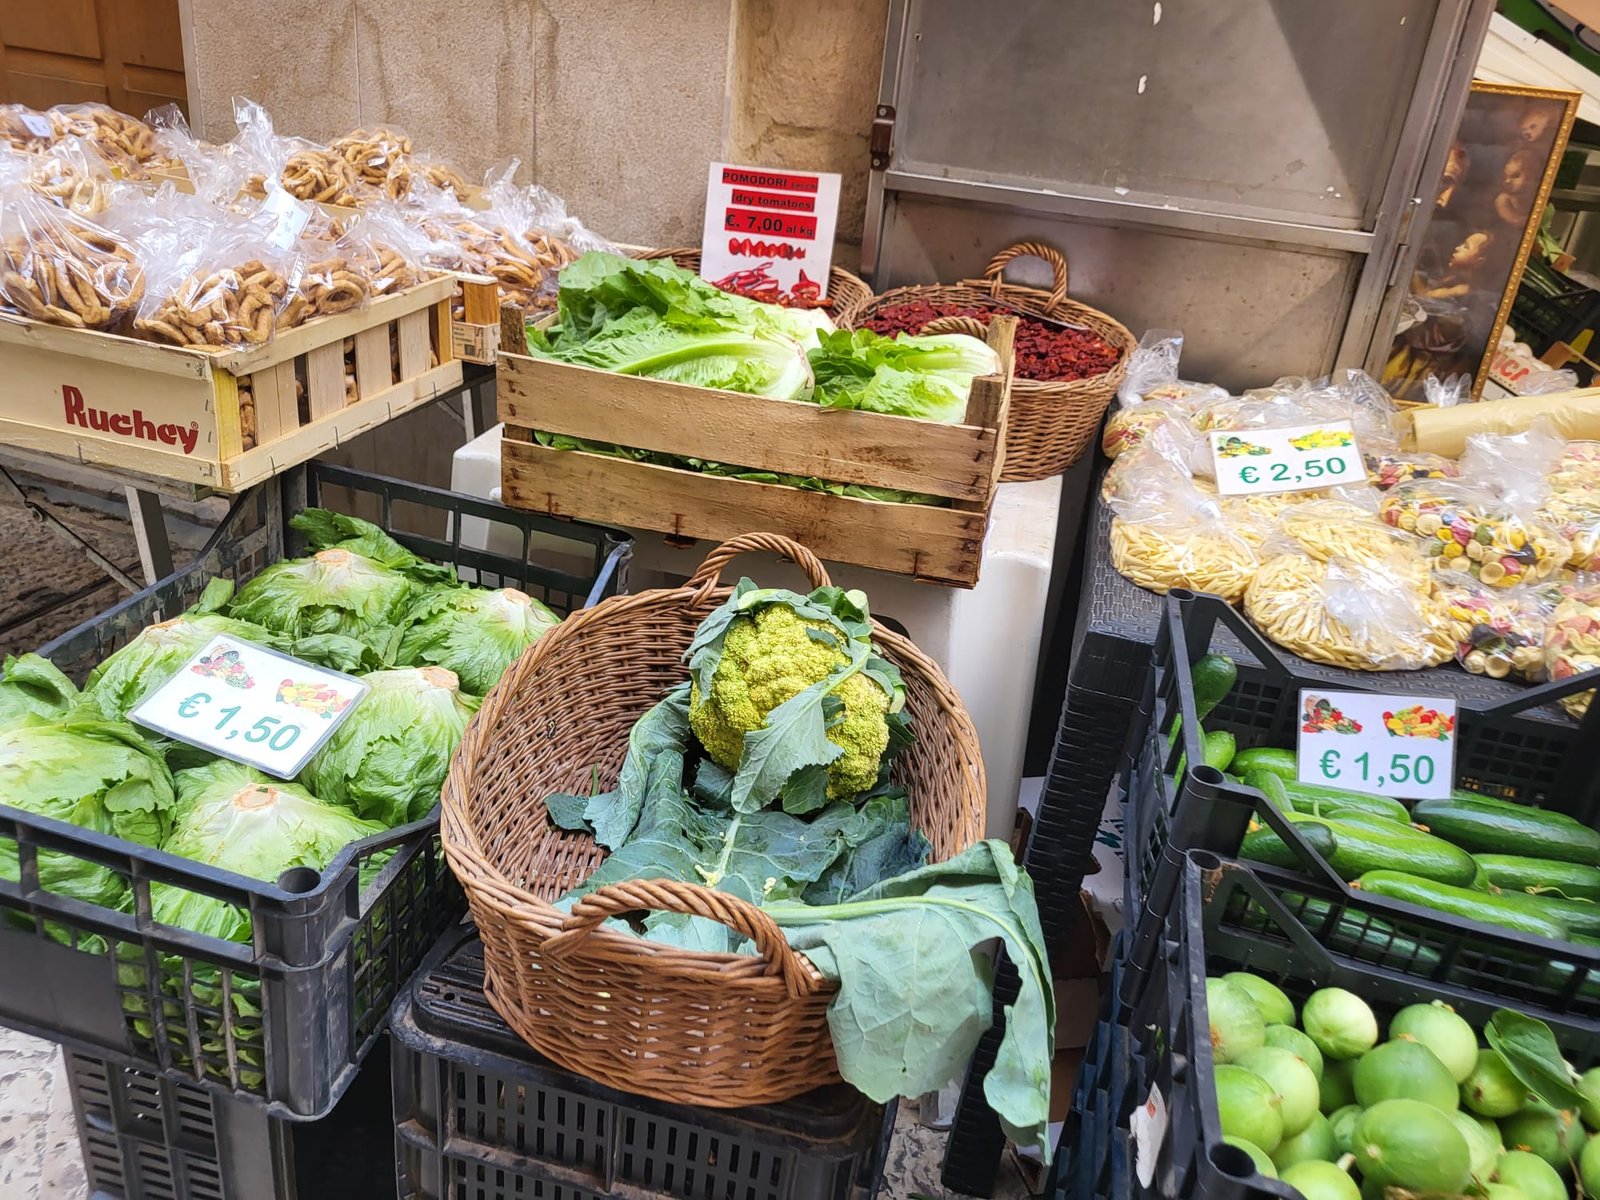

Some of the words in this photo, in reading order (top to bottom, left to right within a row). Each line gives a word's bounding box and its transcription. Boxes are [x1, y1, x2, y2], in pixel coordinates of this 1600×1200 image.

[722, 172, 787, 187] POMODORI
[747, 215, 783, 233] 7,00
[62, 384, 199, 455] Ruchey
[1238, 466, 1260, 484] €
[1270, 457, 1346, 482] 2,50
[178, 692, 211, 718] €
[215, 705, 301, 751] 1,50
[1319, 749, 1341, 779] €
[1354, 751, 1434, 787] 1,50
